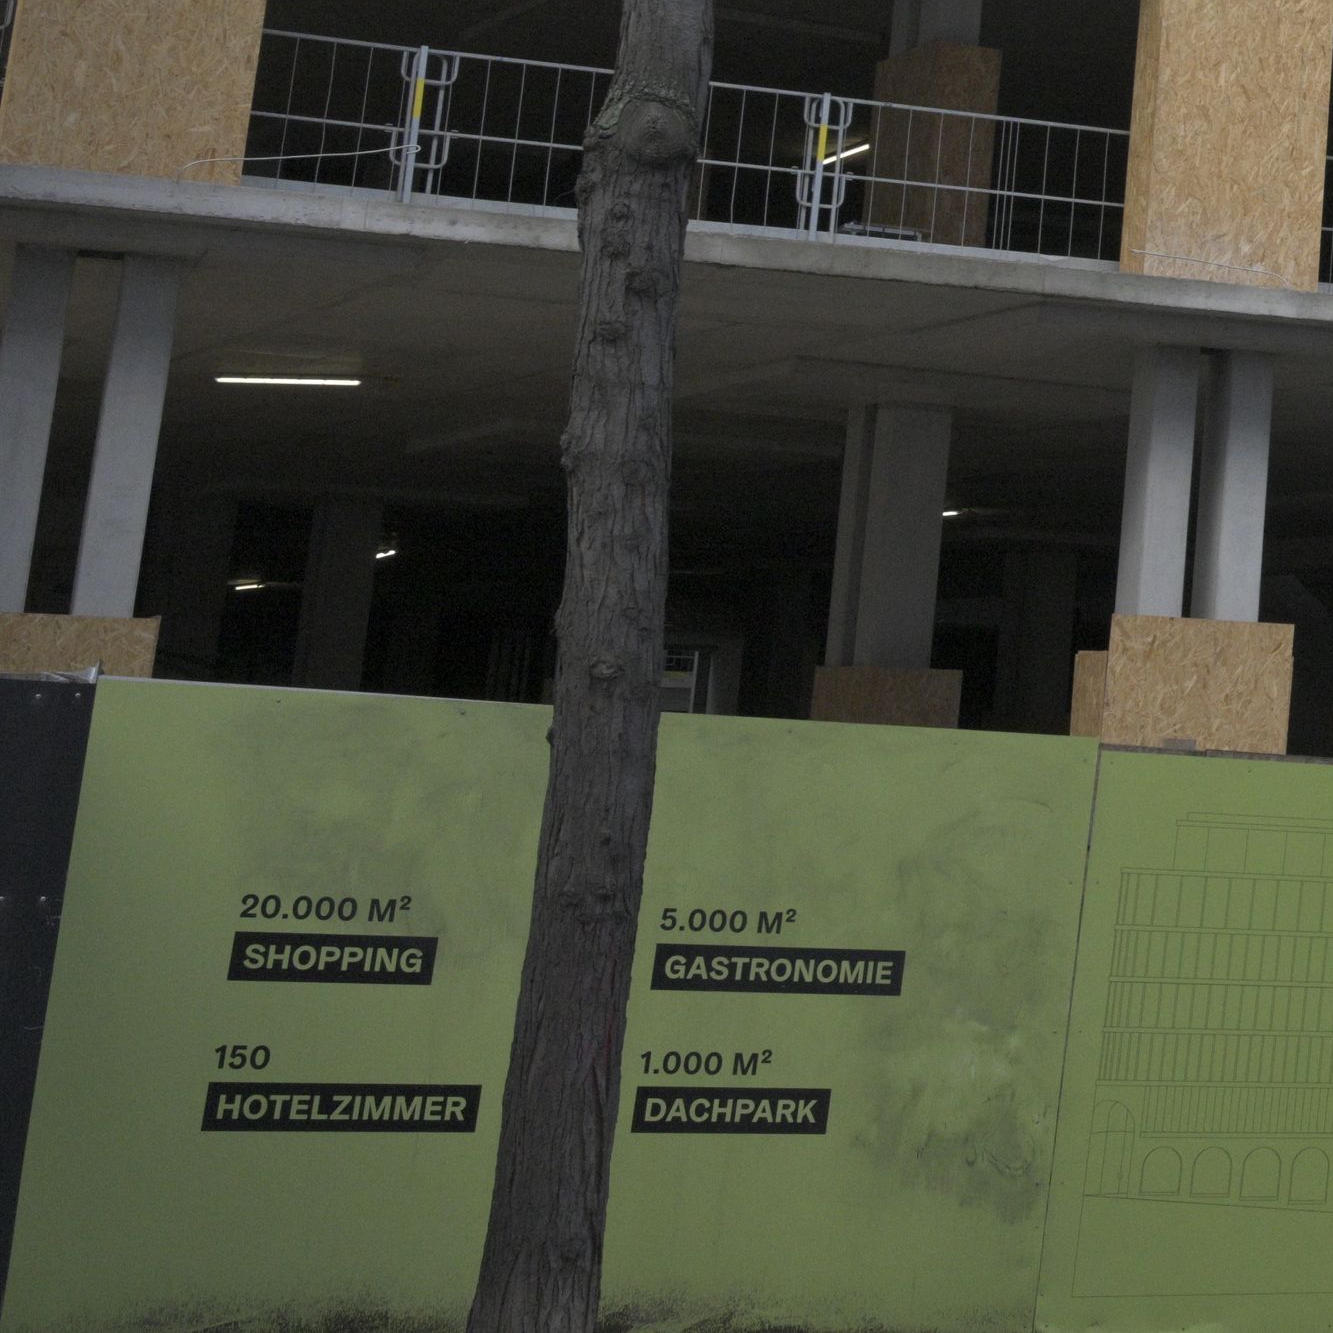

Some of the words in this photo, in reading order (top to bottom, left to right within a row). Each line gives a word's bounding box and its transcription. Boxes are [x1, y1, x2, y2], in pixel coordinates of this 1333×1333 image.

[240, 893, 358, 921] 20.000
[367, 895, 412, 924] M²
[659, 907, 748, 935] 5.000
[756, 908, 797, 937] M²
[243, 943, 424, 973] SHOPPING
[664, 955, 893, 984] GASTRONOMIE
[214, 1045, 270, 1069] 150
[640, 1050, 724, 1077] 1.000
[732, 1050, 773, 1077] M²
[216, 1093, 467, 1121] HOTELZIMMER
[644, 1096, 817, 1123] DACHPARK
